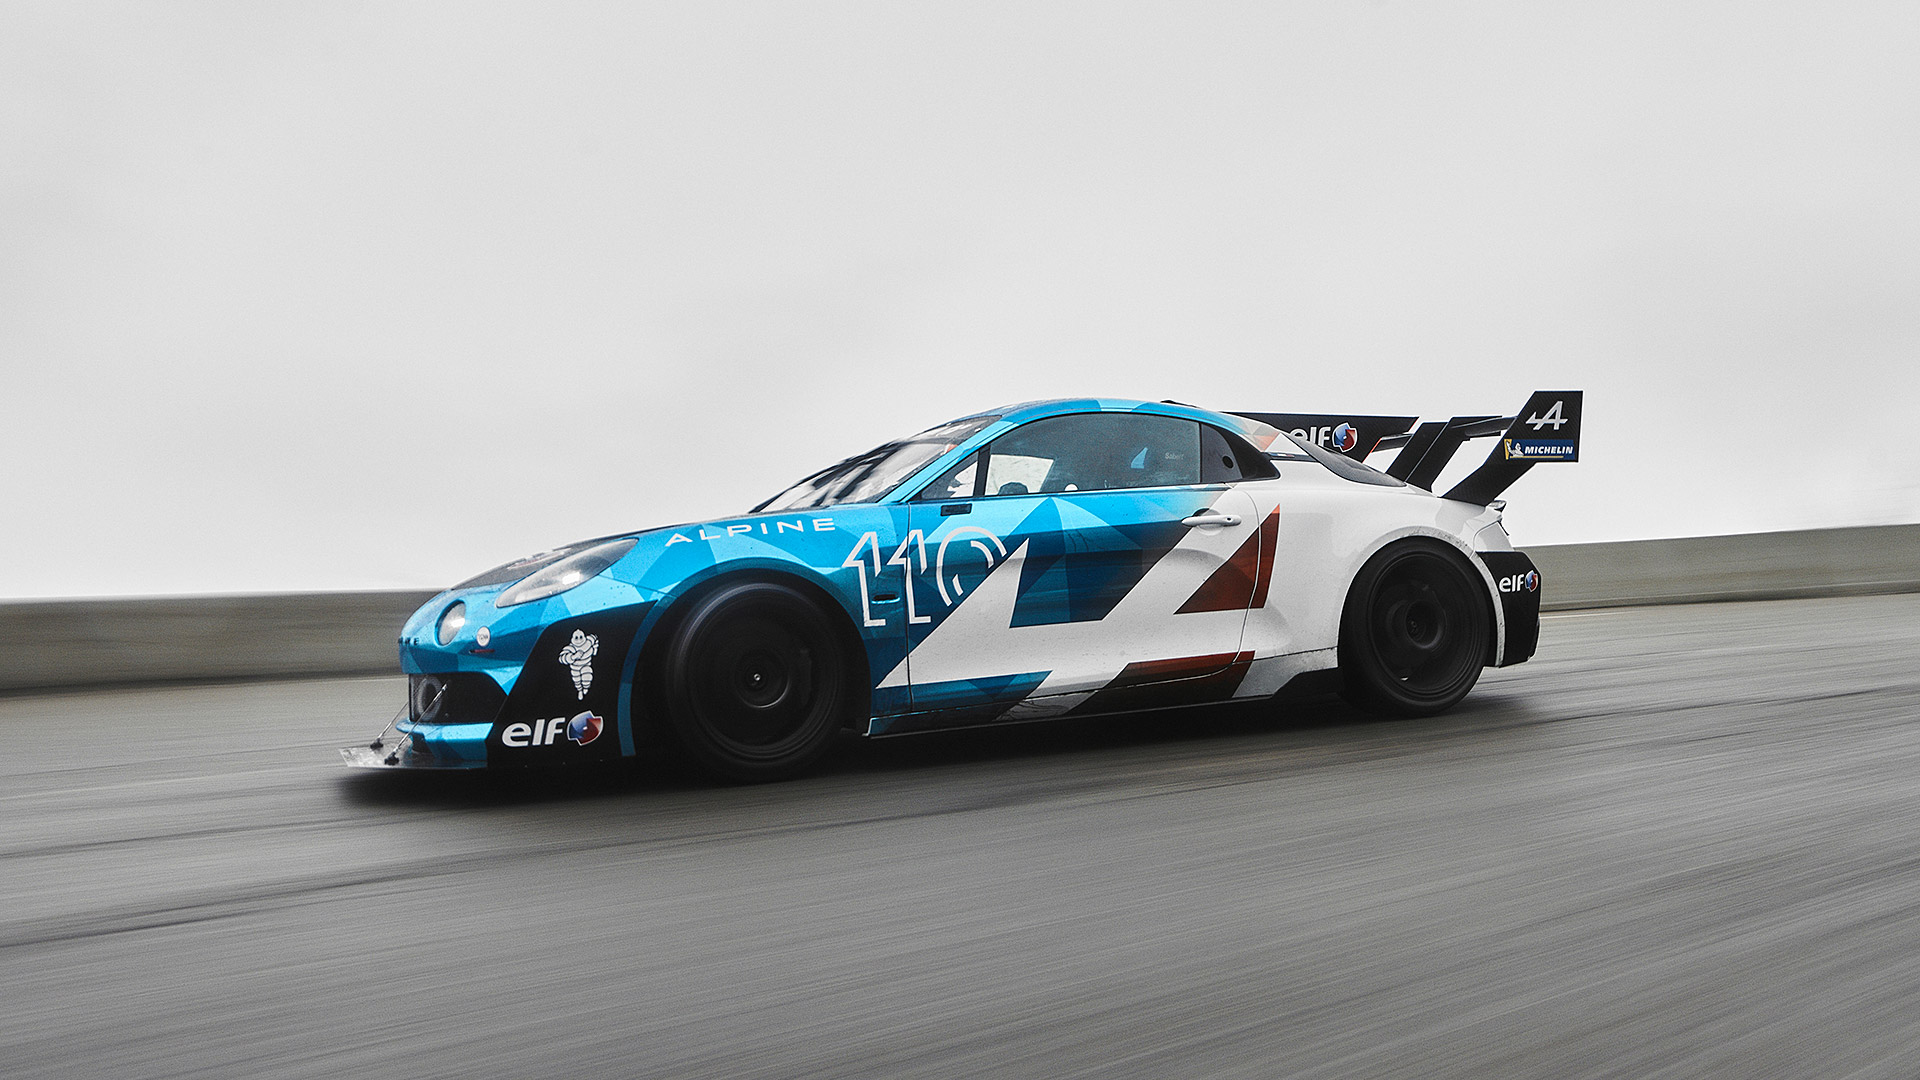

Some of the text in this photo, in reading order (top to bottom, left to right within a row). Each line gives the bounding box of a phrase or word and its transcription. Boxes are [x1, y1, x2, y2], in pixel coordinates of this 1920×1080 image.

[1524, 446, 1573, 454] MICHELIN
[665, 518, 836, 547] ALPINE
[842, 526, 1007, 627] 110
[1499, 573, 1525, 593] elf
[502, 717, 566, 747] elf
